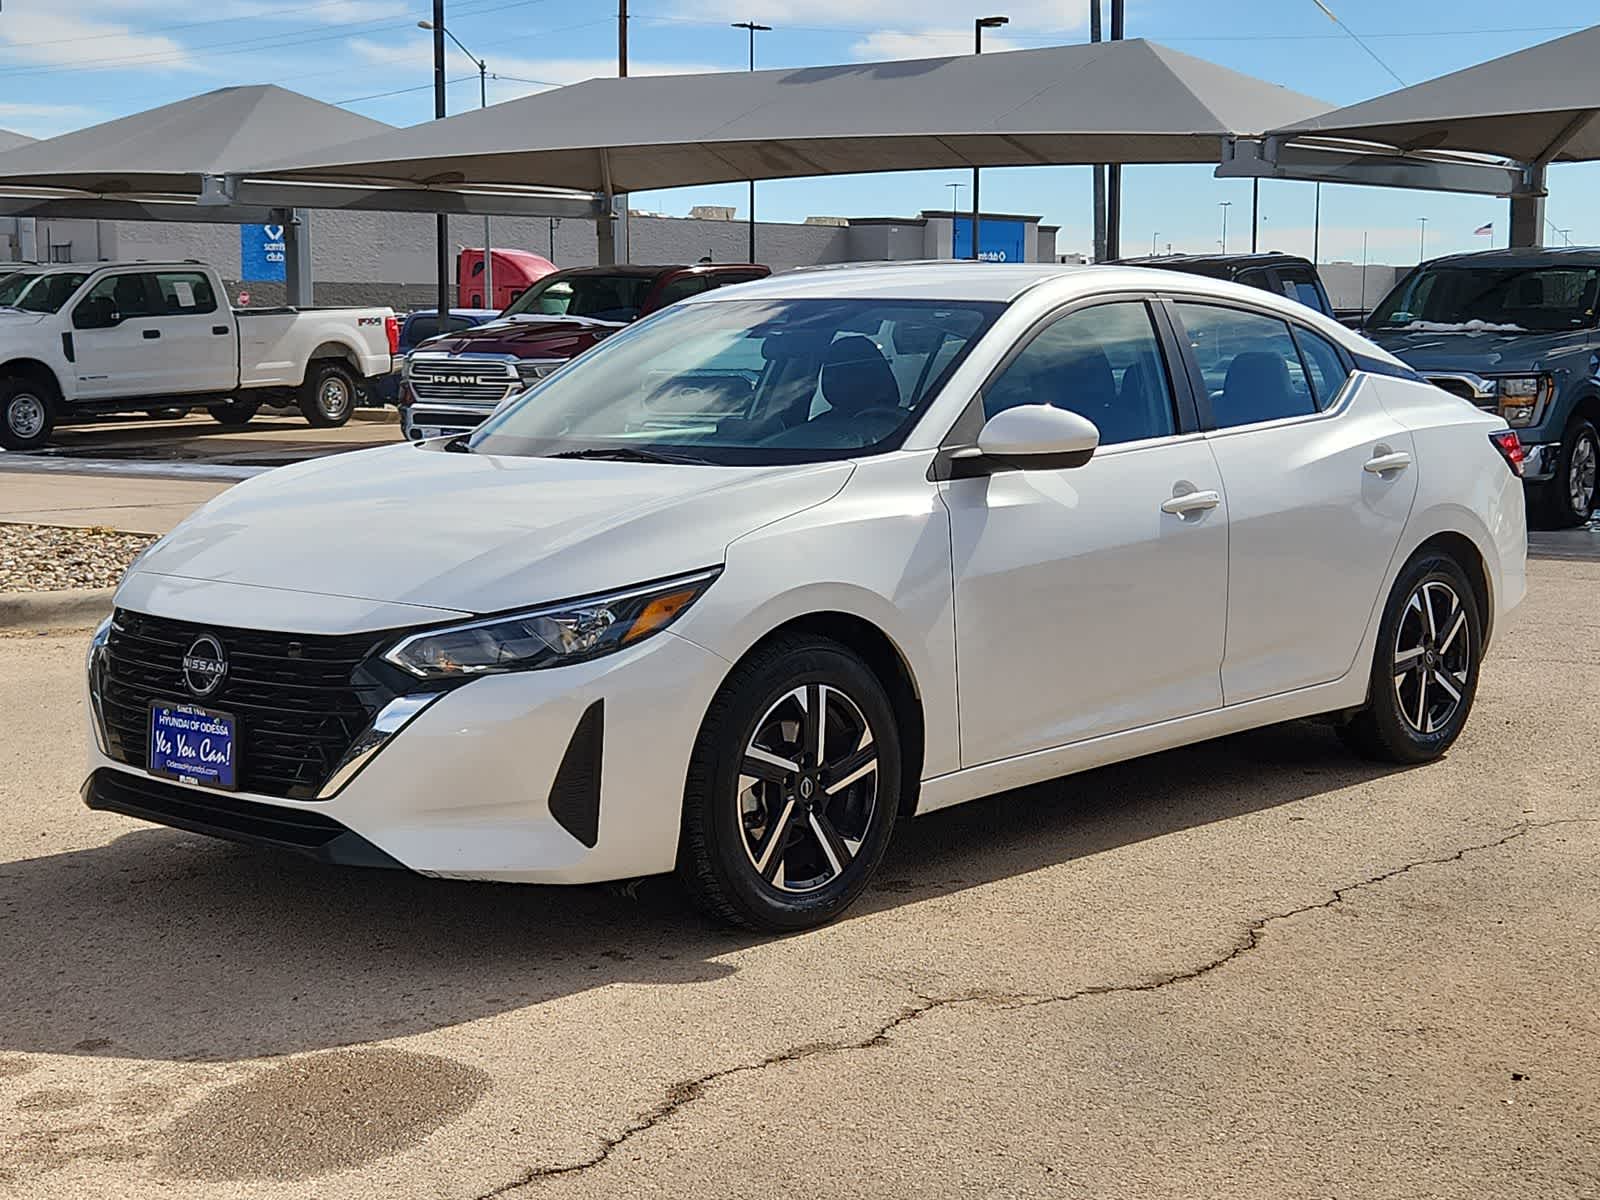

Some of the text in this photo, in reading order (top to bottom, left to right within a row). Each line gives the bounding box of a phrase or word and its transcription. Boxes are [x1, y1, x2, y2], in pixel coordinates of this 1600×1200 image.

[266, 252, 284, 262] club
[433, 375, 475, 384] RAM
[183, 656, 225, 673] NISSAN
[159, 714, 229, 736] HYUNDAI OF ODESSA
[155, 730, 232, 766] Yes You Can!
